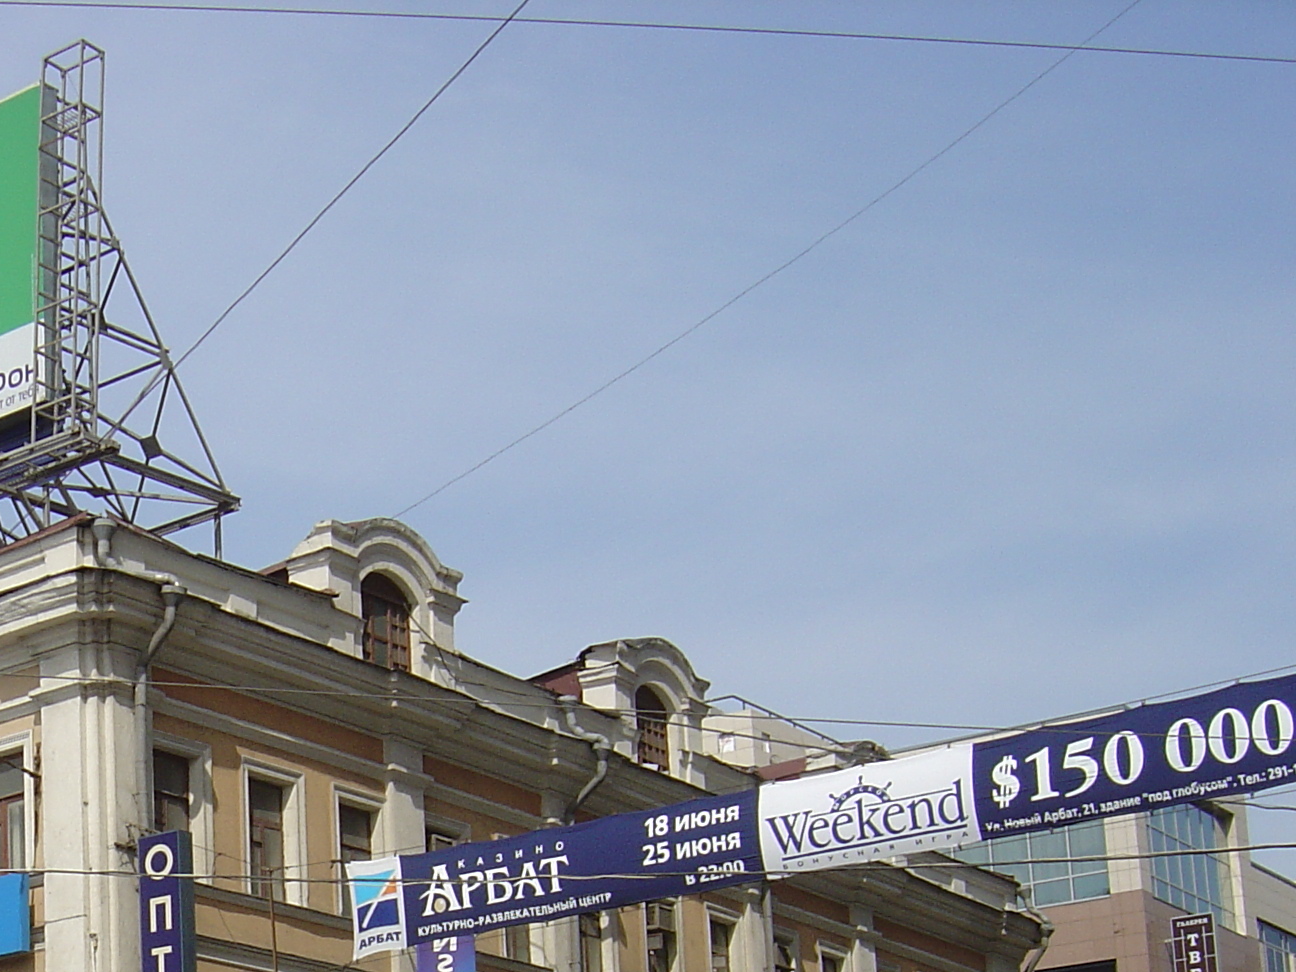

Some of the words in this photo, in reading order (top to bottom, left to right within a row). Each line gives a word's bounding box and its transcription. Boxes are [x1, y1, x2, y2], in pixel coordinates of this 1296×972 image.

[991, 730, 1145, 809] $150
[1164, 699, 1295, 773] 000
[765, 778, 970, 855] Weekend
[1044, 808, 1082, 823] Арбат,
[1083, 803, 1099, 816] 21,
[1100, 796, 1142, 812] здание
[643, 815, 669, 839] 18
[457, 841, 565, 870] КАЗИНО
[642, 841, 671, 867] 25
[783, 844, 896, 870] БОНУСНАЯ
[914, 831, 970, 846] ИГРА
[417, 896, 578, 937] КУЛЬТУРНО-РАЗВЛЕКАТЕЛЬНЫЙ
[579, 891, 613, 909] ЦЕНТР
[359, 930, 402, 950] АРБАТ
